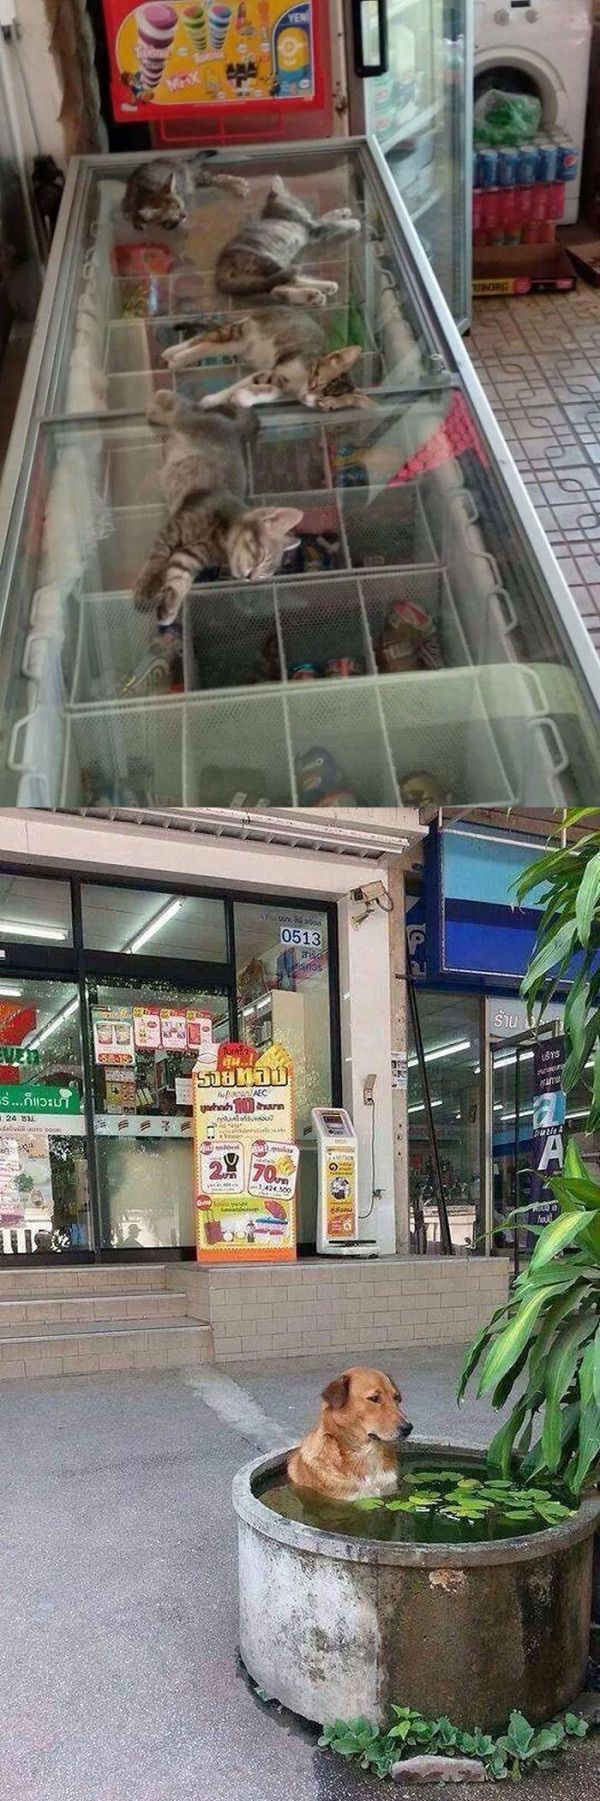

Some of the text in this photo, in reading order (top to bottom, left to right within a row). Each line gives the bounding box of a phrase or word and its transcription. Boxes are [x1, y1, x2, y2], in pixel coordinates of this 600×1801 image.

[282, 929, 322, 946] 0513
[494, 1009, 519, 1029] ร้าน
[538, 1134, 564, 1171] A
[209, 1161, 222, 1180] 2
[252, 1164, 276, 1184] 70
